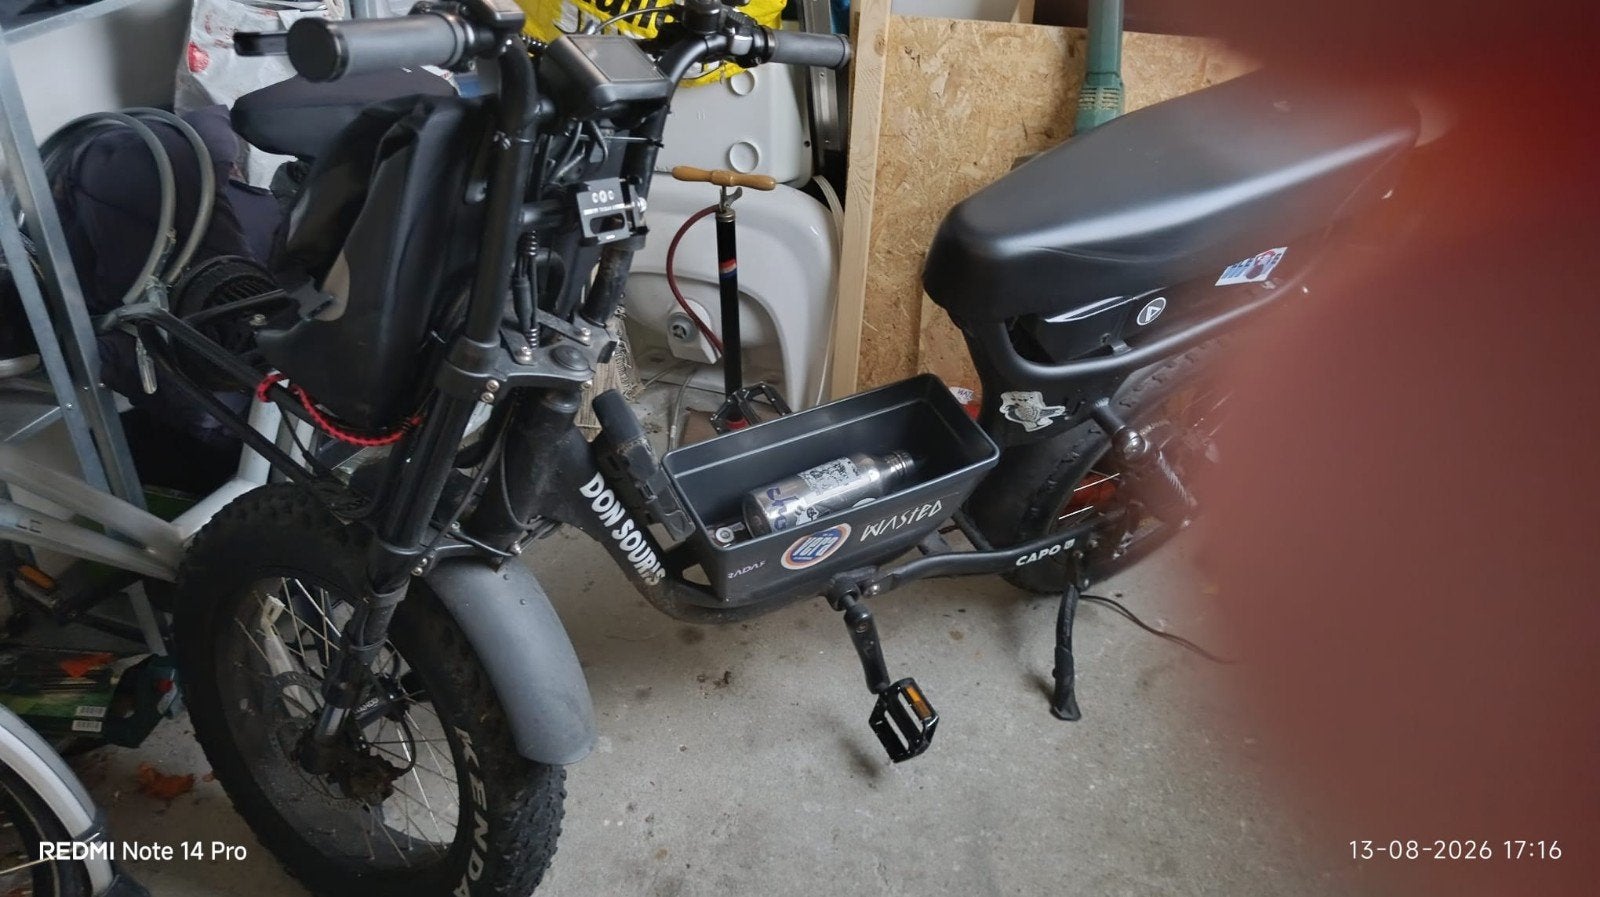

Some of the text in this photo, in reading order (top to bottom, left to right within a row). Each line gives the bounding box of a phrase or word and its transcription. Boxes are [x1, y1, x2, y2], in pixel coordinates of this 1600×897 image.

[579, 471, 666, 586] DON SOURIS
[1015, 544, 1062, 567] CAPO
[453, 725, 489, 897] KENDA
